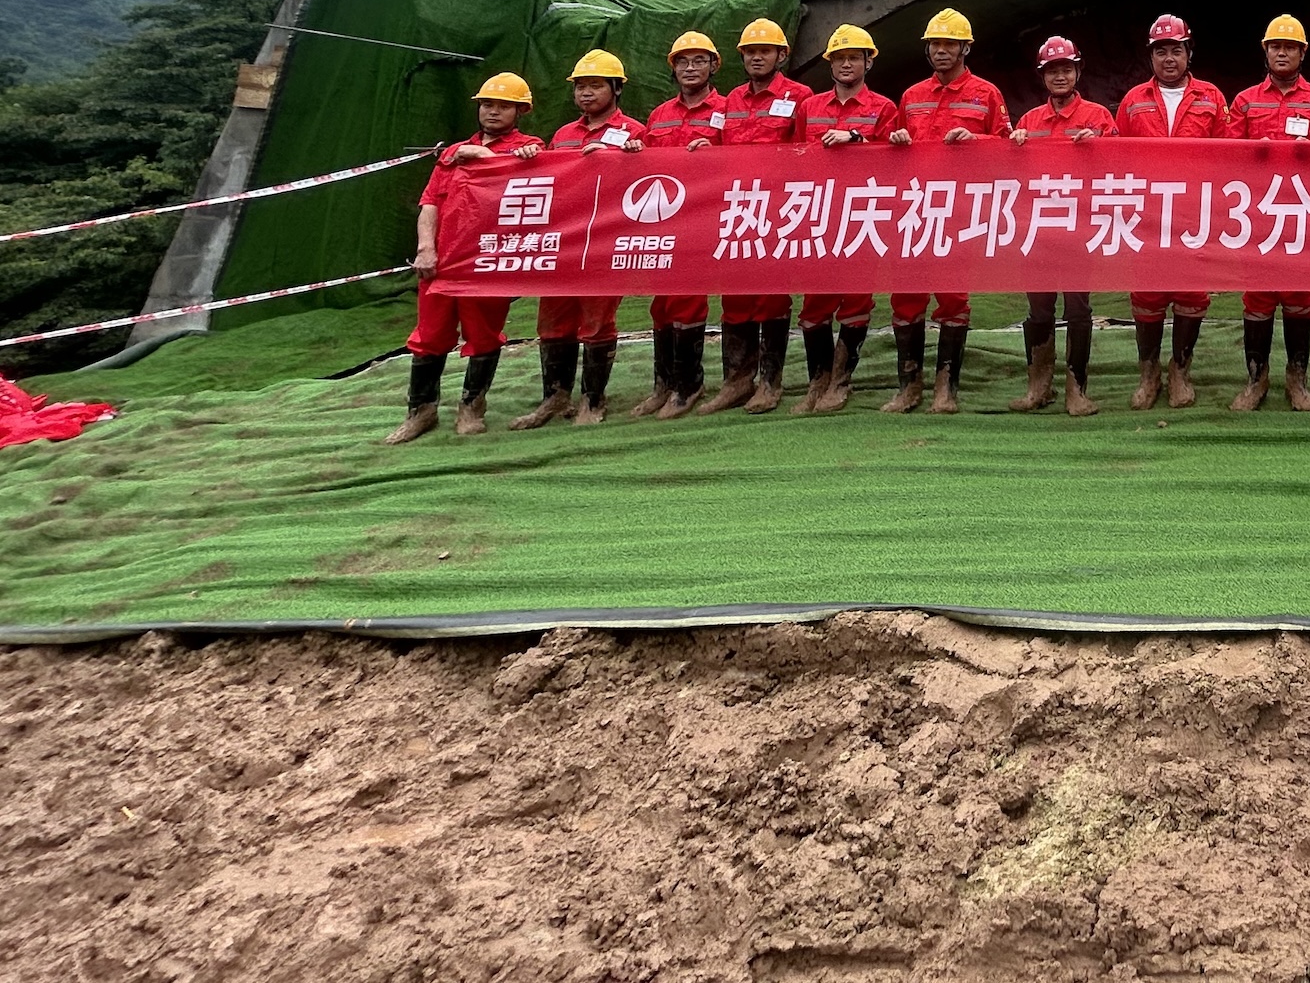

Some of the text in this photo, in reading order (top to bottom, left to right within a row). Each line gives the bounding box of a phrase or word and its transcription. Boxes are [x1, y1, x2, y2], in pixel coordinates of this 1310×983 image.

[478, 232, 562, 254] 蜀道集团
[473, 255, 558, 272] SDIG
[611, 253, 673, 270] 四川路桥
